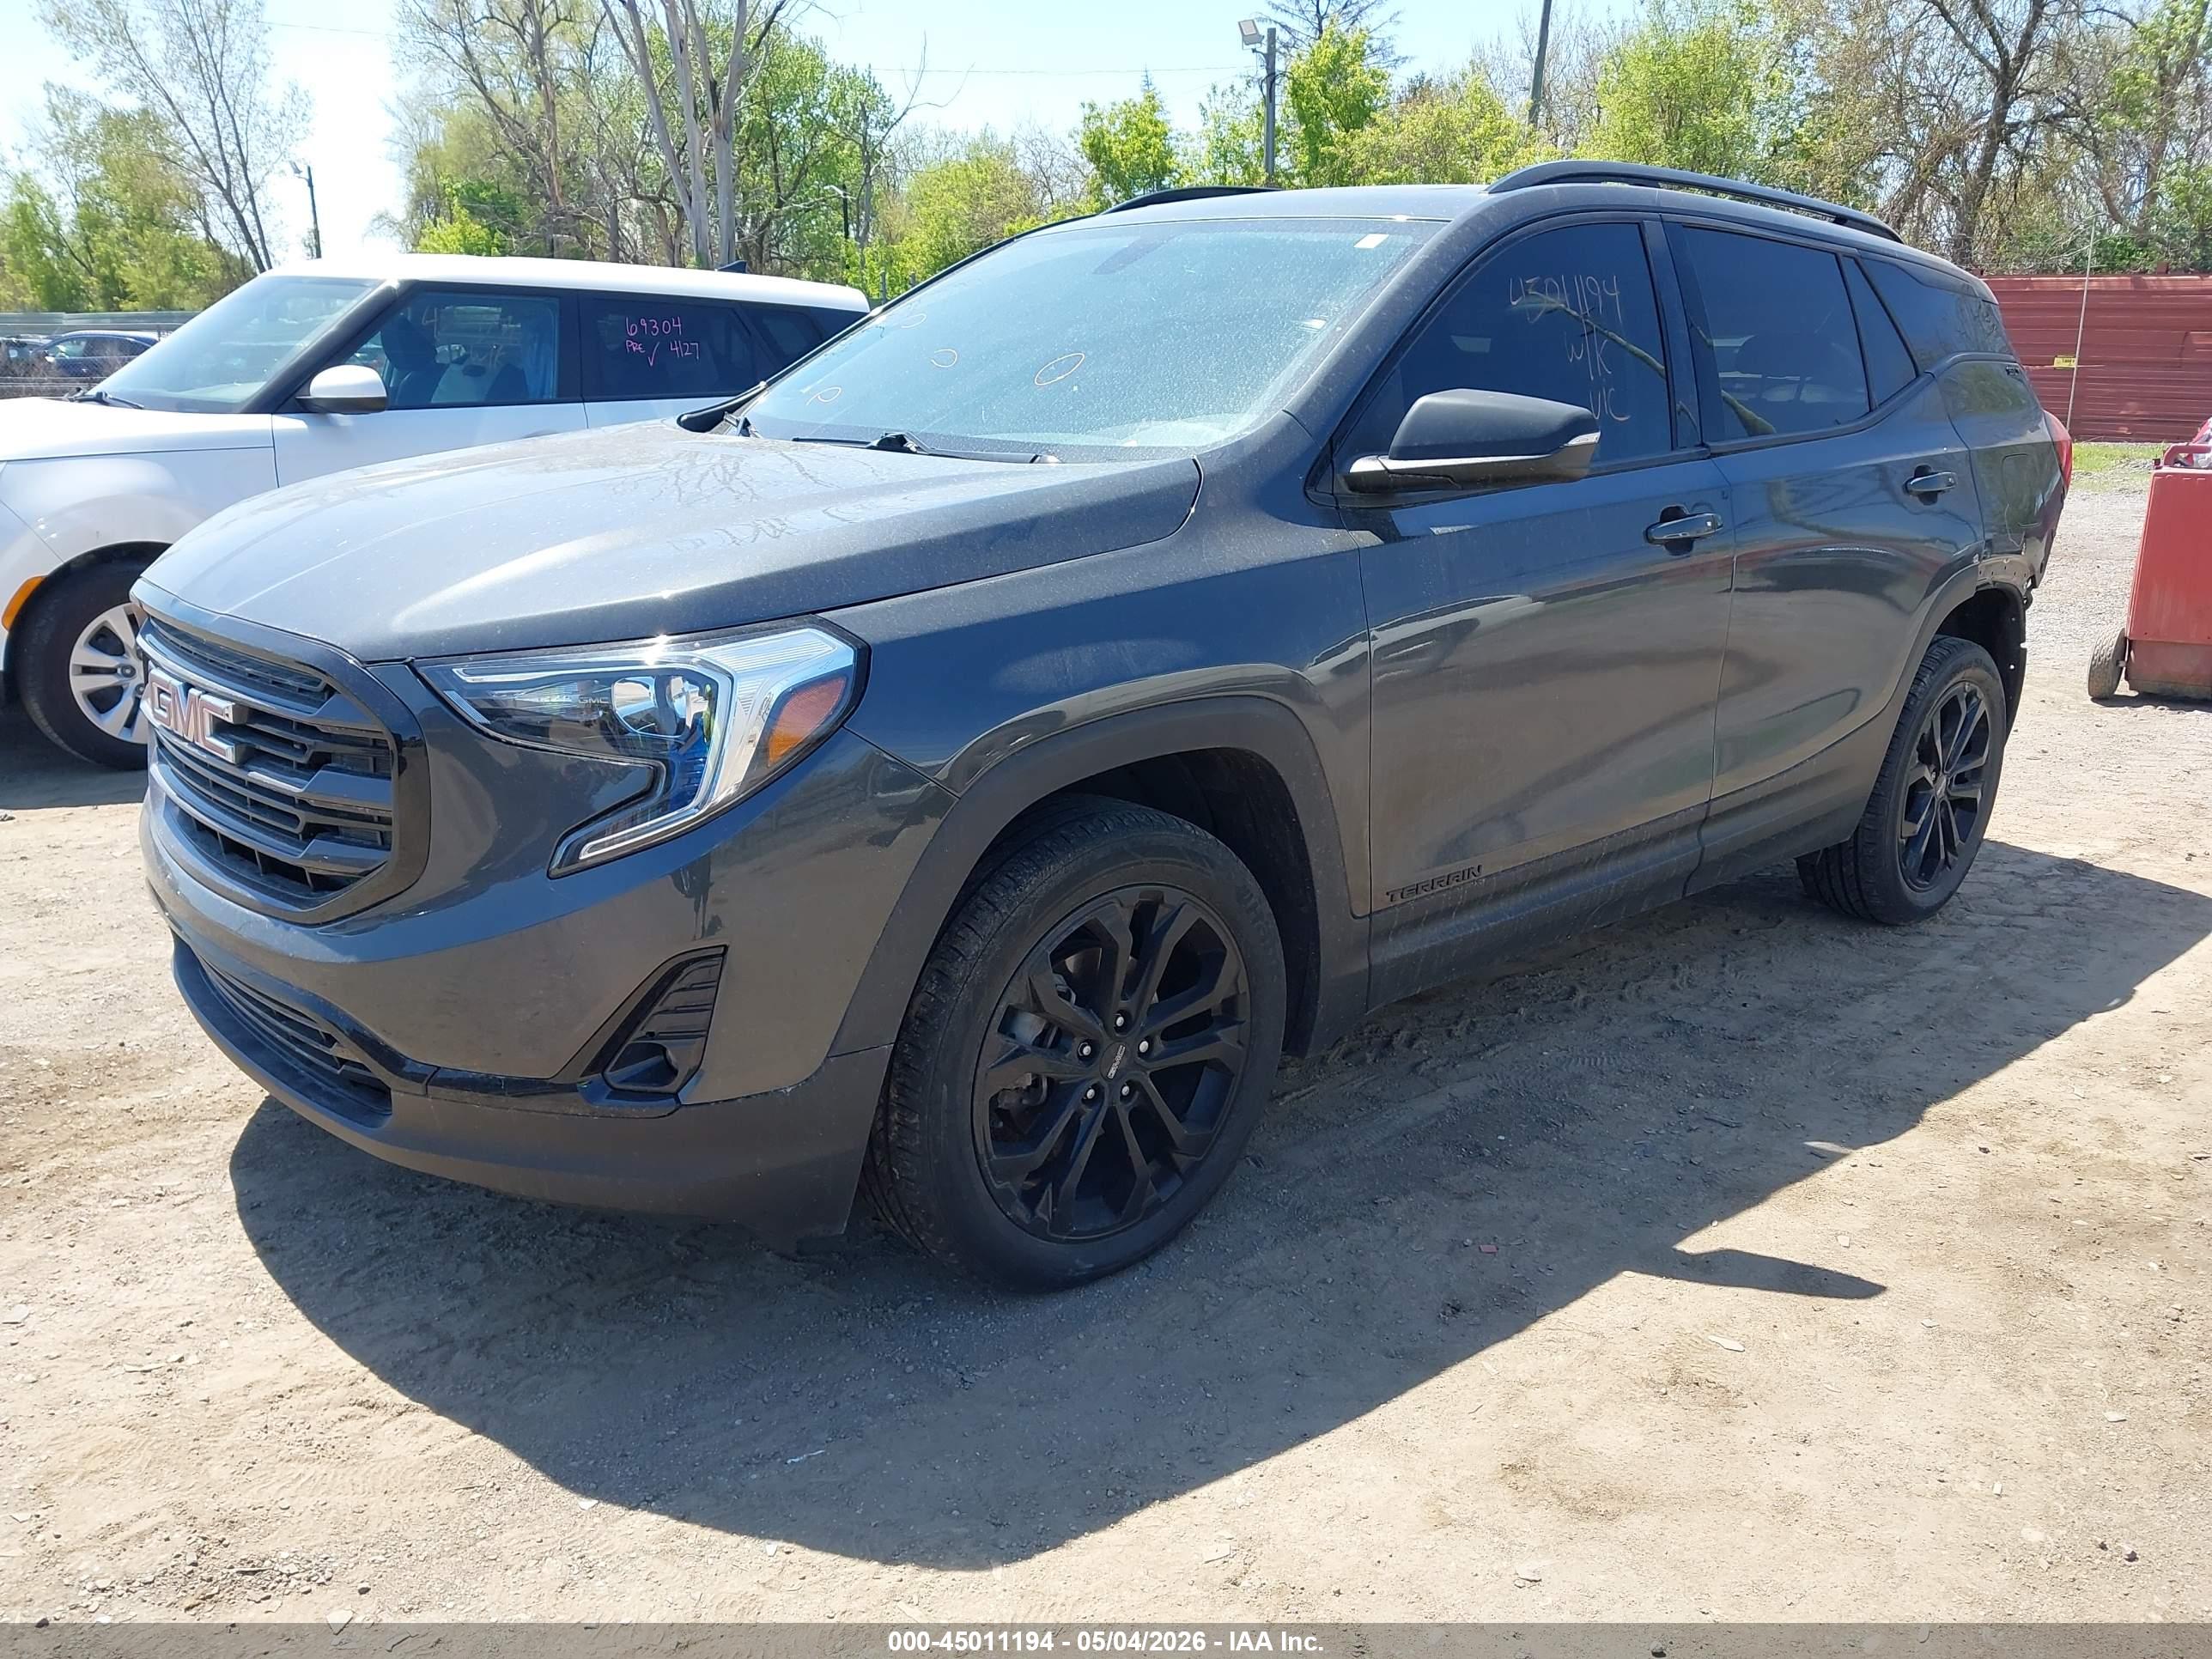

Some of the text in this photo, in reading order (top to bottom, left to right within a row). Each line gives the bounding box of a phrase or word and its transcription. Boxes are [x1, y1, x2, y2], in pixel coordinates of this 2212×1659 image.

[625, 316, 683, 337] 69304
[578, 695, 610, 704] GMC
[146, 668, 236, 764] GMC
[1385, 864, 1483, 902] TERRAIN
